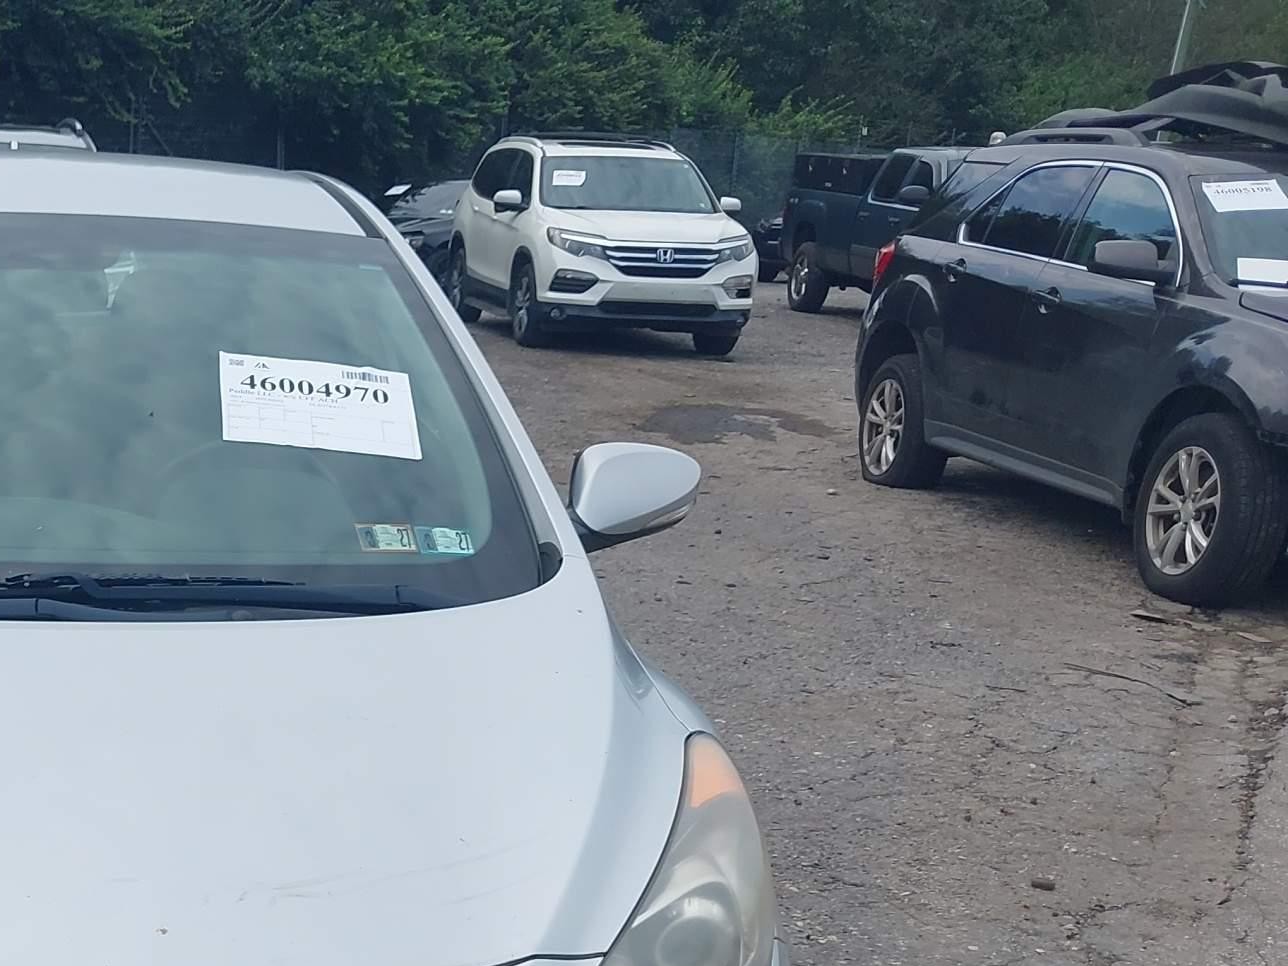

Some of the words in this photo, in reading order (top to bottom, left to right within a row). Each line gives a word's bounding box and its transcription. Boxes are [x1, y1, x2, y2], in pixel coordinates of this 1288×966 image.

[240, 374, 390, 404] 46004970
[397, 528, 412, 548] 27
[455, 531, 470, 552] 27
